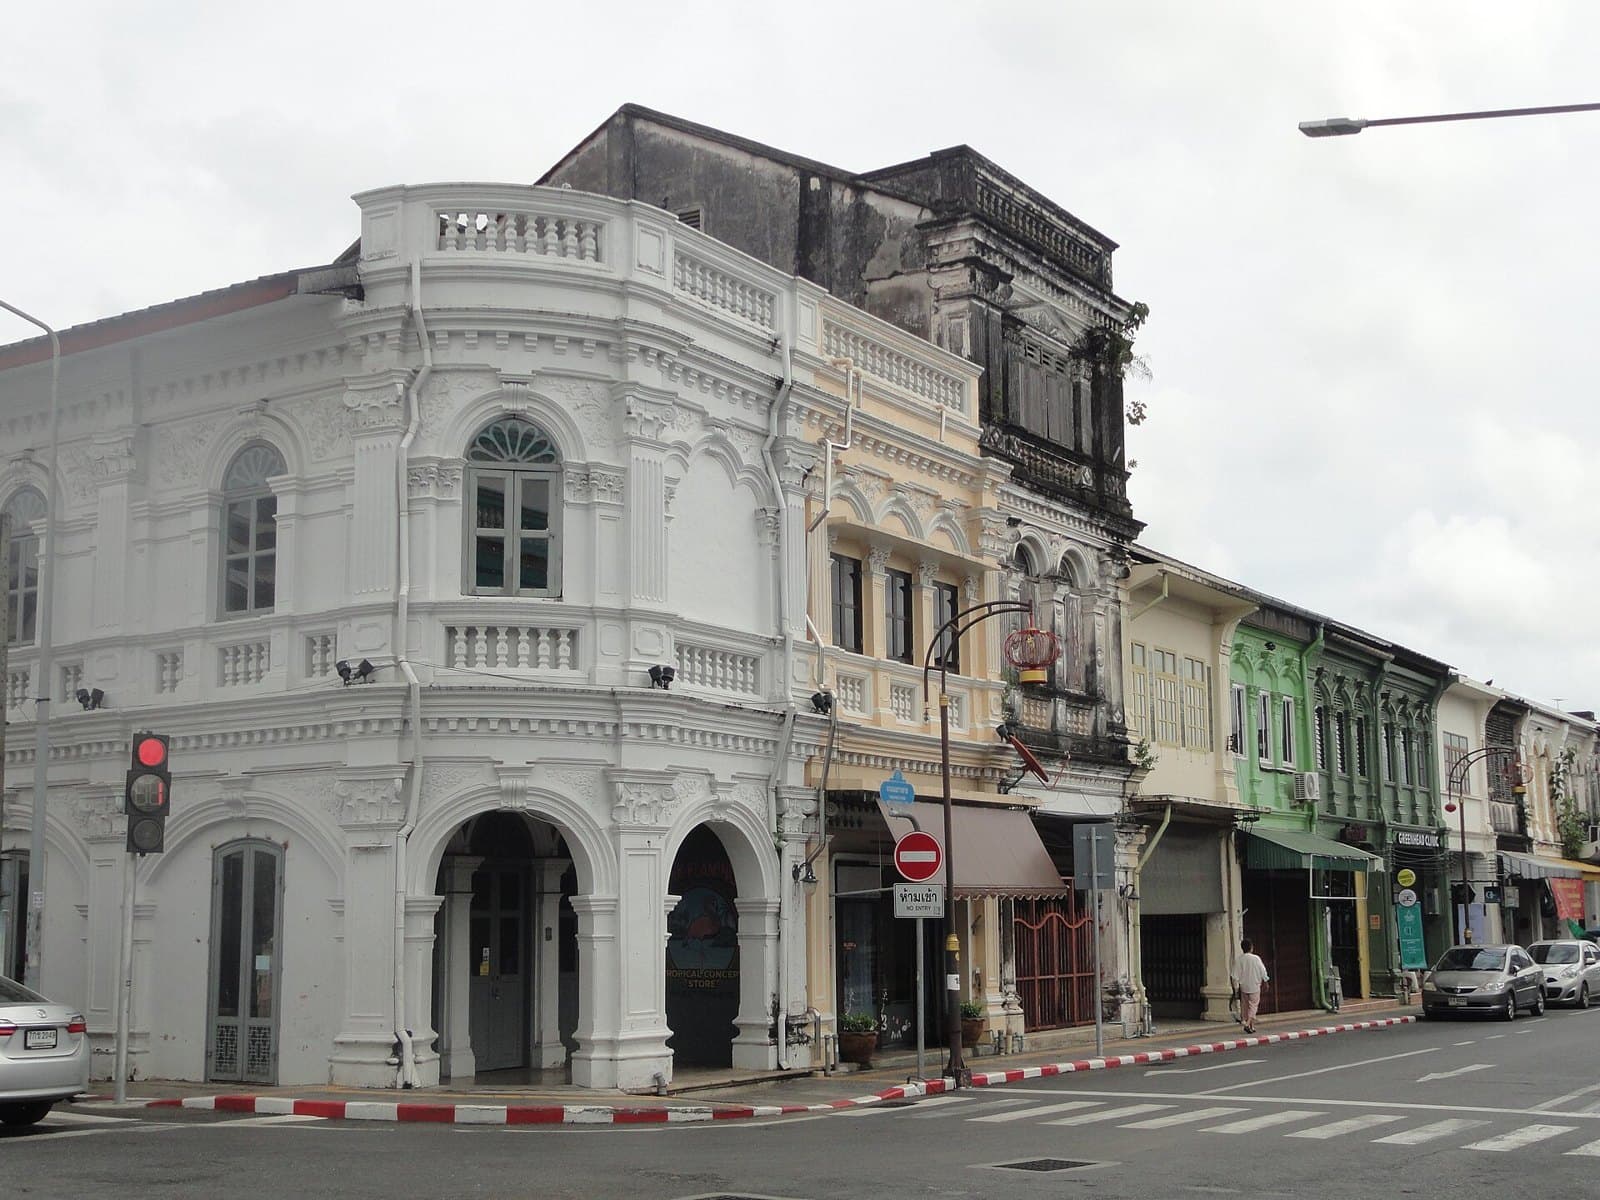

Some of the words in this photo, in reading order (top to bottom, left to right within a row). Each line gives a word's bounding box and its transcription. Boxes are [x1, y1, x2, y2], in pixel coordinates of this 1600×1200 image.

[899, 888, 937, 902] ห้ามเข้า
[666, 969, 701, 978] ROPICAL
[703, 969, 738, 978] CONCEP
